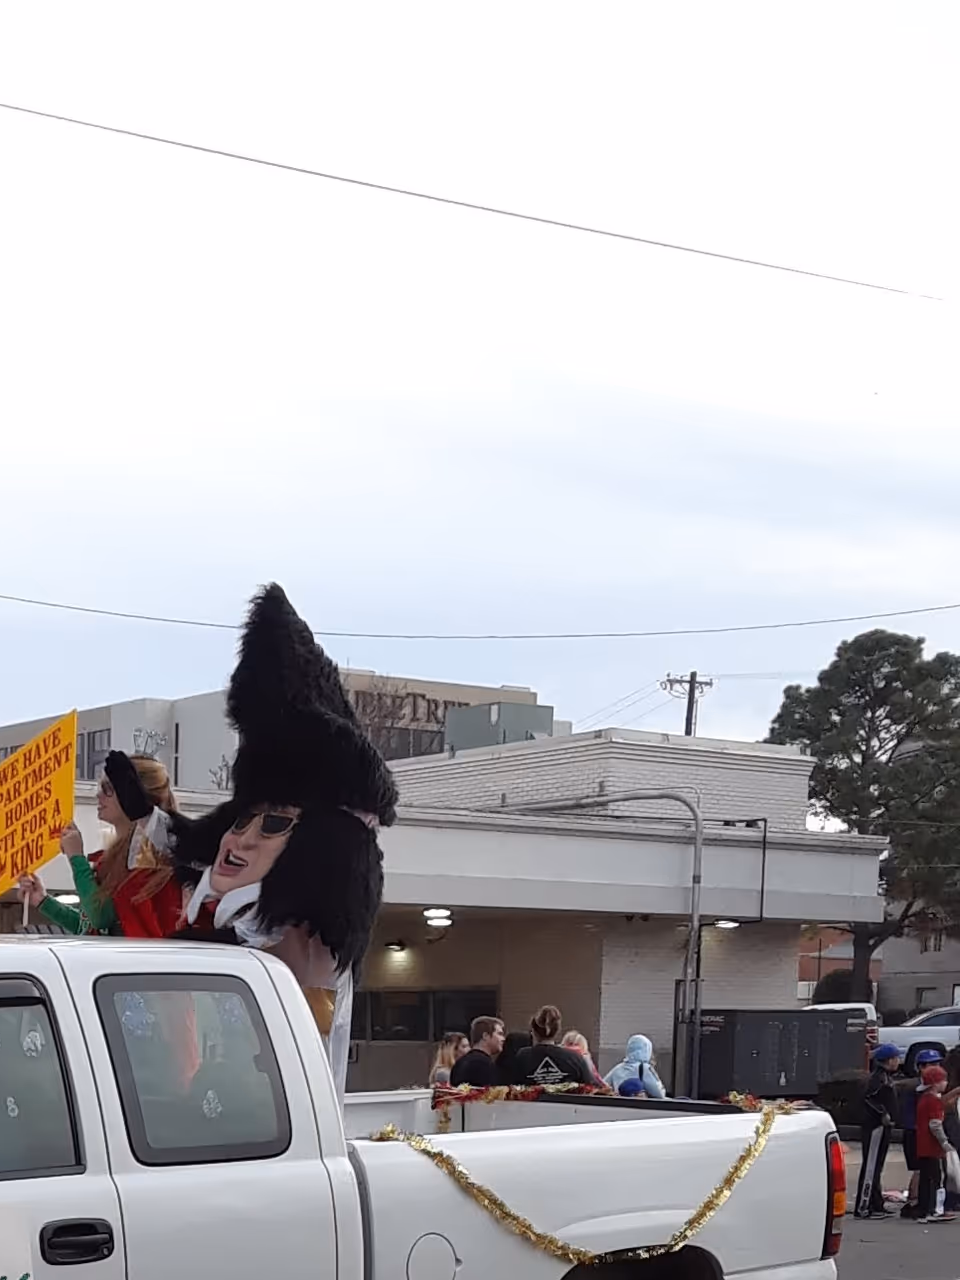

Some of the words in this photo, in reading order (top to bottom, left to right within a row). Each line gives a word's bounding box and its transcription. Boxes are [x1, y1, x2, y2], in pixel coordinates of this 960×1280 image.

[23, 727, 61, 770] HAVE
[5, 781, 52, 829] HOMES
[21, 808, 47, 840] FOR
[52, 799, 61, 819] A
[10, 832, 44, 879] KING
